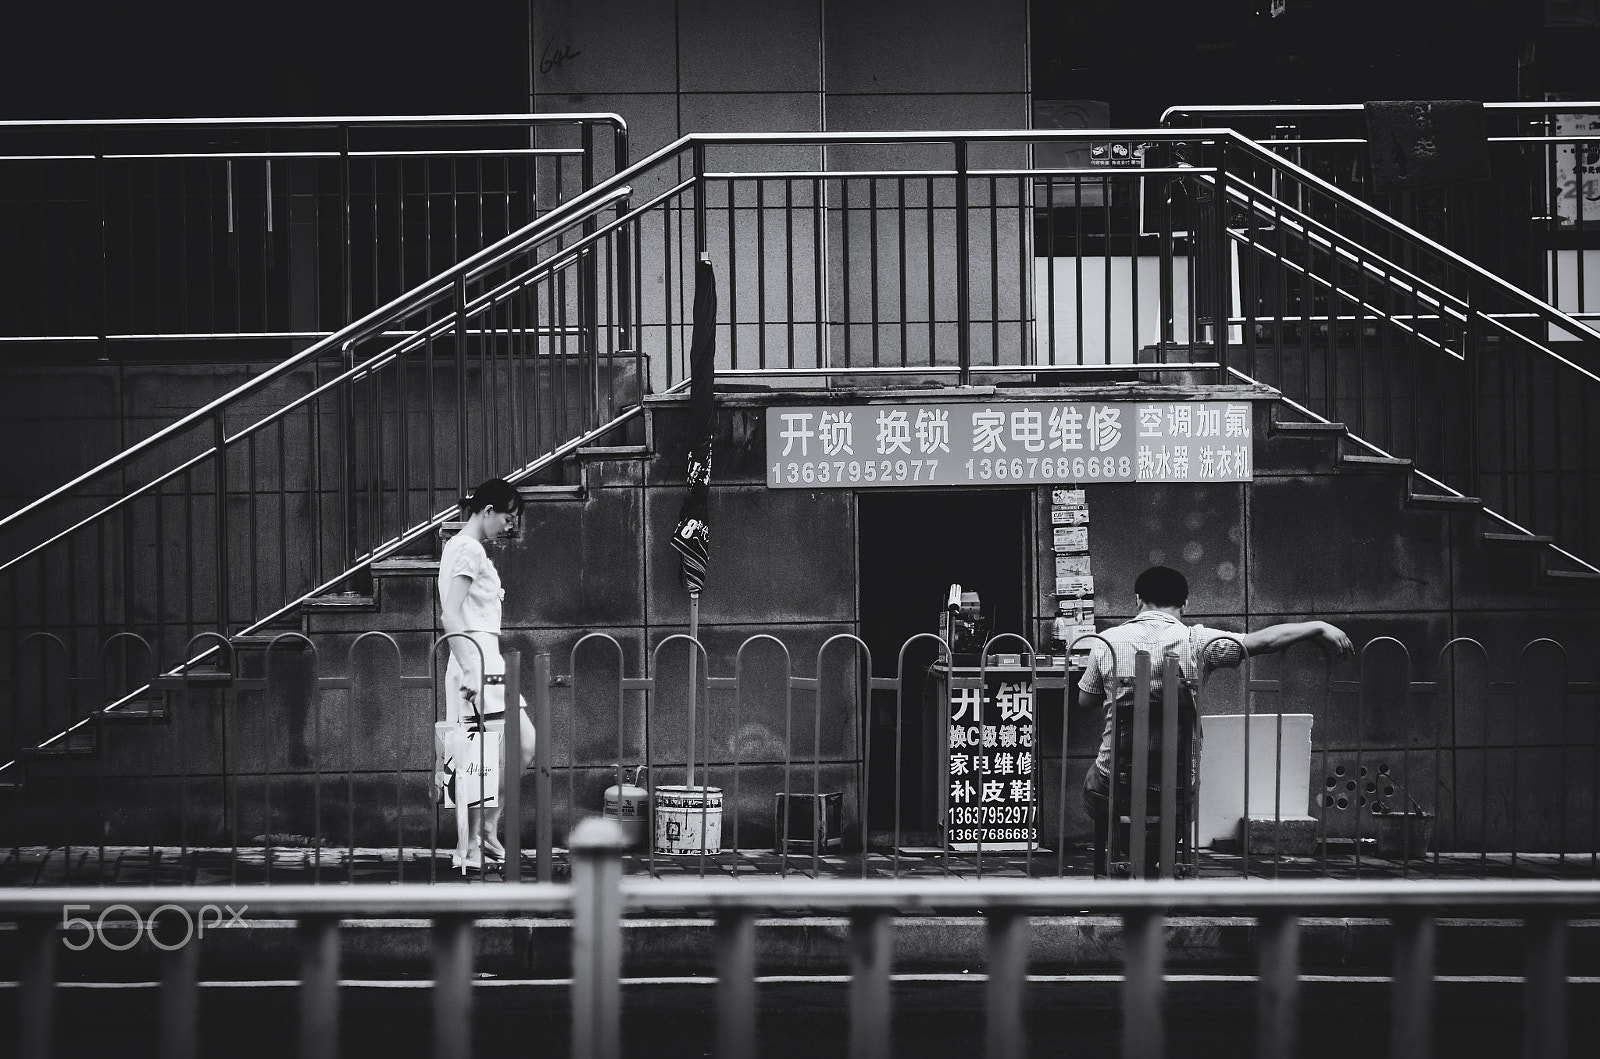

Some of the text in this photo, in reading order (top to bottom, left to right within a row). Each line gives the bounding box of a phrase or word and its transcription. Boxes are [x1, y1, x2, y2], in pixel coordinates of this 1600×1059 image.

[780, 405, 1123, 456] 开锁 换锁 家电维修
[1139, 404, 1250, 438] 空调加氟
[772, 456, 1132, 484] 13637952977 13667686688
[1138, 445, 1250, 479] 热水器 洗衣机
[951, 681, 1036, 722] 开锁
[950, 752, 1037, 776] 家电维修
[950, 780, 1037, 803] 补皮鞋
[948, 806, 1037, 824] 13637952977
